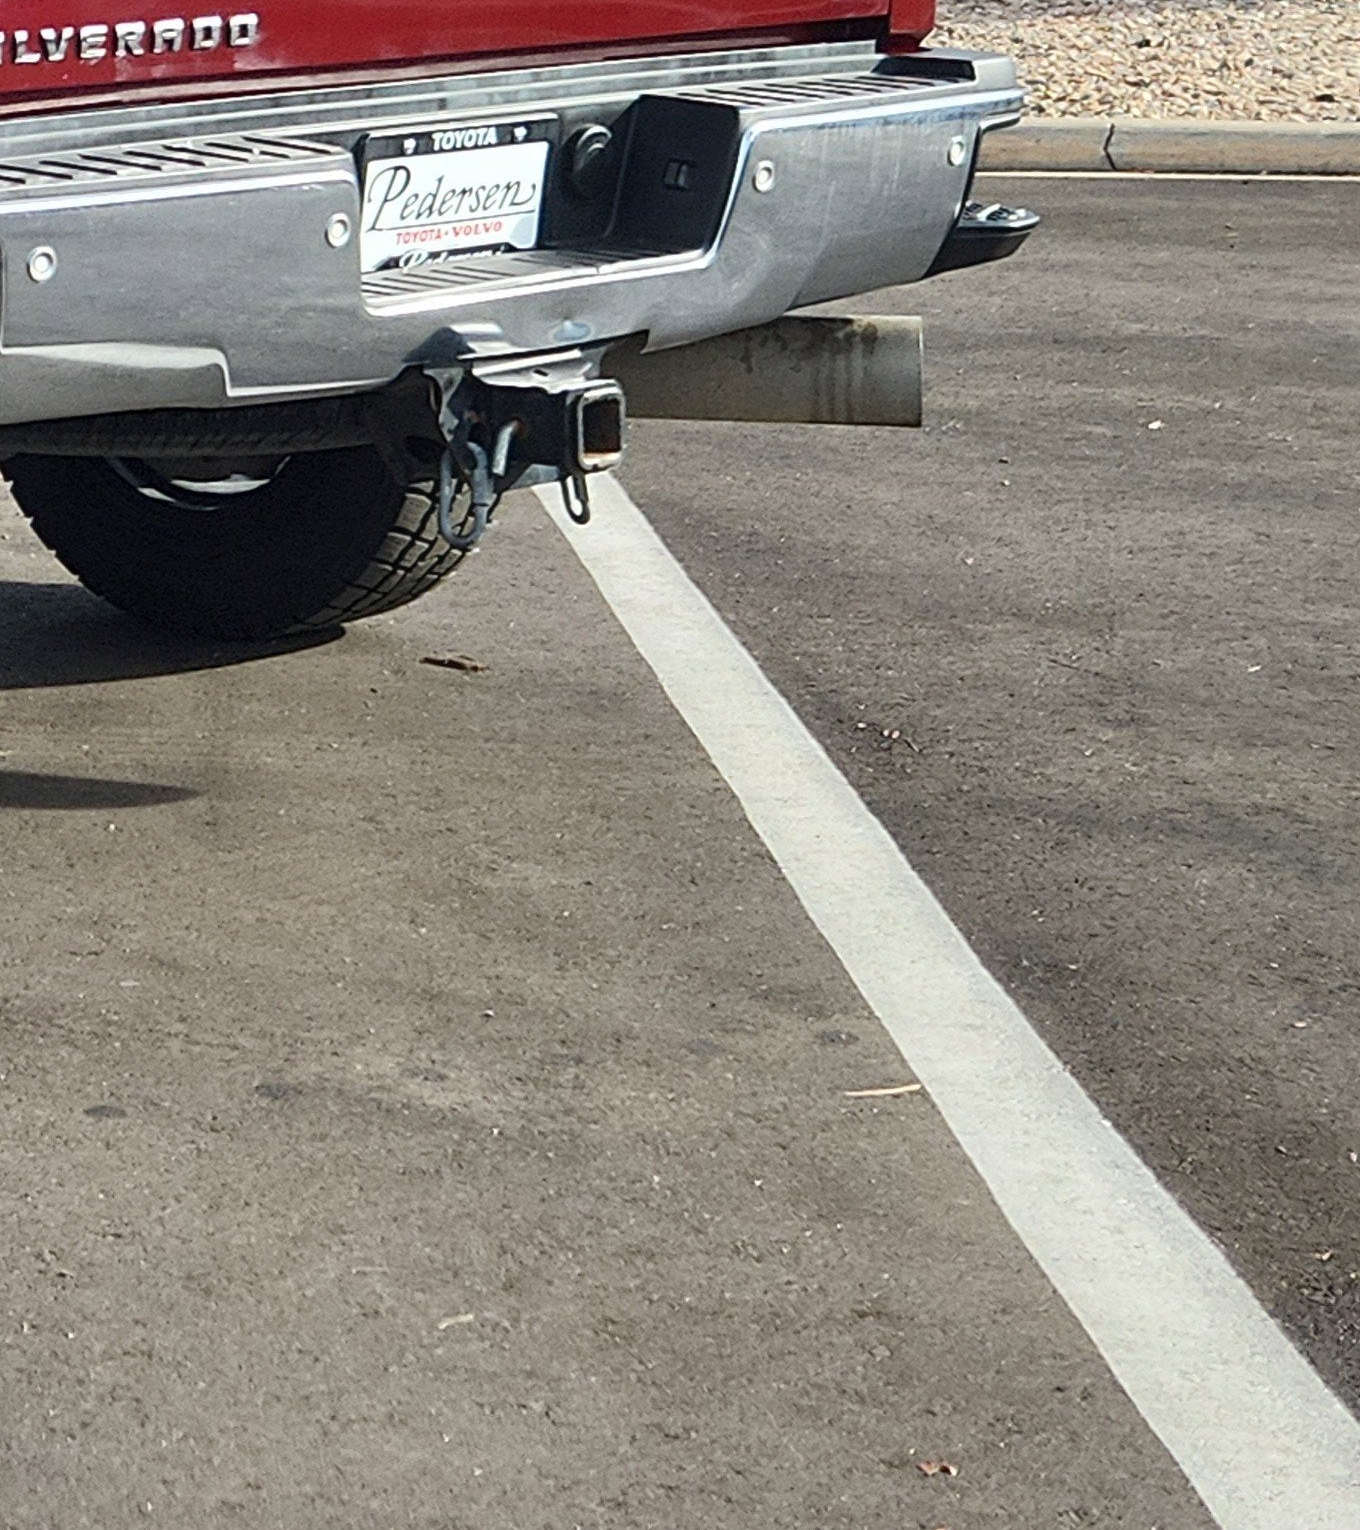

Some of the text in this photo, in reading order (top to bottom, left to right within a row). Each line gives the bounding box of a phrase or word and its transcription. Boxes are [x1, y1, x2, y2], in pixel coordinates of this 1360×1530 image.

[431, 126, 499, 151] TOYOTA
[365, 164, 537, 233] Pedersen
[395, 220, 503, 246] TOYOTA VOLVO
